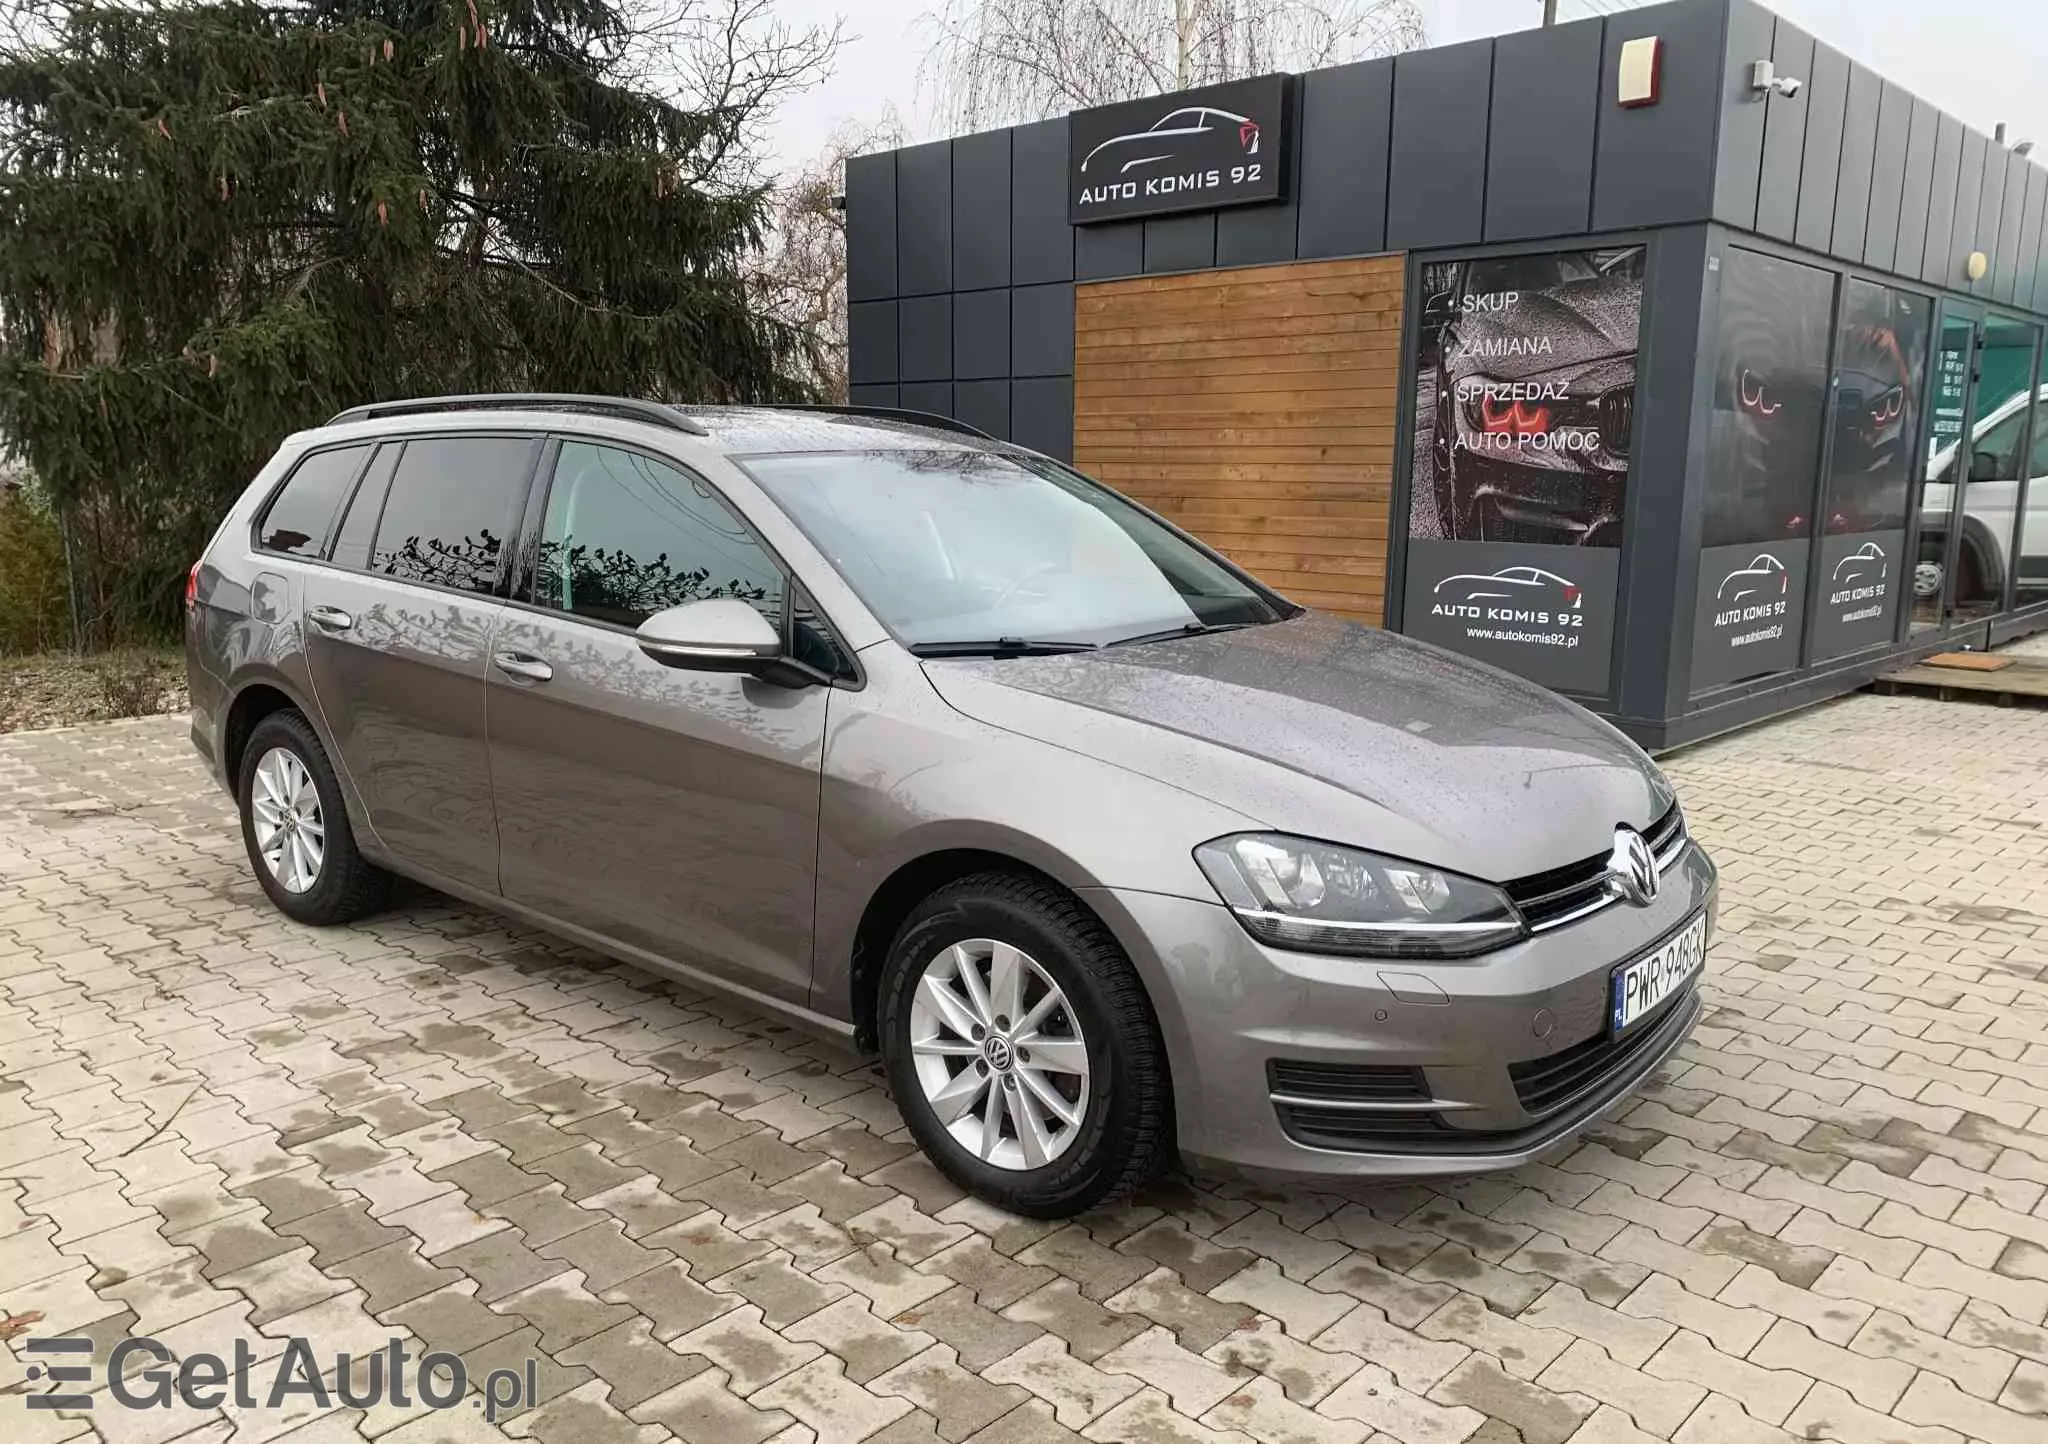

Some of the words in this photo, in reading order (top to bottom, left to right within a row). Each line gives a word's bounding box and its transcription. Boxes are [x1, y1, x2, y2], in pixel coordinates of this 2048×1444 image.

[1079, 181, 1137, 205] AUTO
[1145, 169, 1220, 196] KOMIS
[1230, 163, 1262, 184] 92
[1462, 291, 1519, 313] SKUP
[1458, 336, 1552, 358] ZAMIANA
[1454, 432, 1512, 451] AUTO
[1517, 431, 1601, 451] POMOC
[1831, 590, 1850, 604] AUTO
[1431, 603, 1481, 618] AUTO
[1487, 607, 1549, 624] KOMIS
[1557, 614, 1583, 627] 92
[1714, 609, 1741, 627] AUTO
[1742, 603, 1772, 622] KOMIS
[1773, 600, 1787, 617] 92
[1466, 626, 1579, 649] www.autokomis92.pl
[1625, 956, 1661, 1020] PWR
[1665, 916, 1706, 993] 948GK
